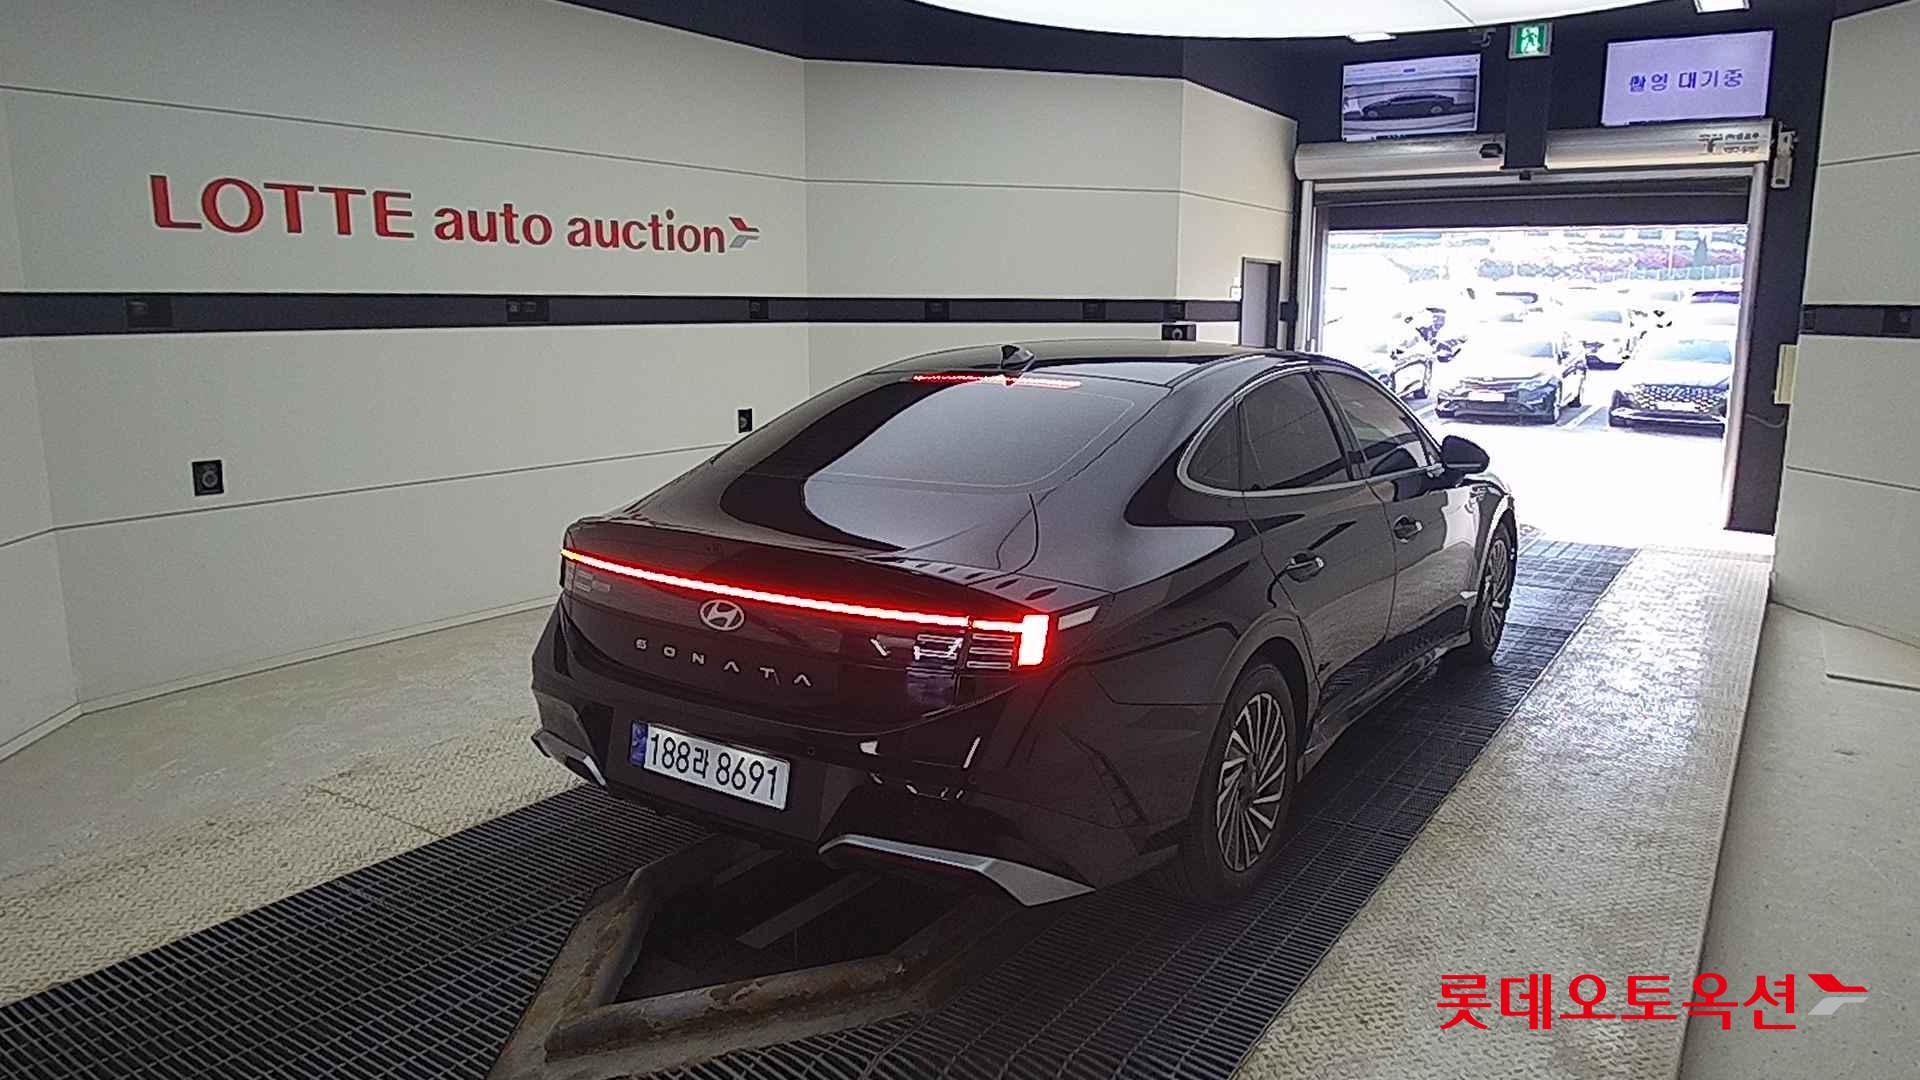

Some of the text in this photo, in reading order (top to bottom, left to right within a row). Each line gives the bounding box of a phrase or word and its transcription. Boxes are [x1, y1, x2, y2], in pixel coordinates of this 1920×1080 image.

[1678, 68, 1744, 89] 대기중
[149, 174, 726, 254] LOTTE auto auction
[635, 638, 812, 688] SONATA
[650, 733, 710, 780] 188라
[715, 752, 779, 801] 8691
